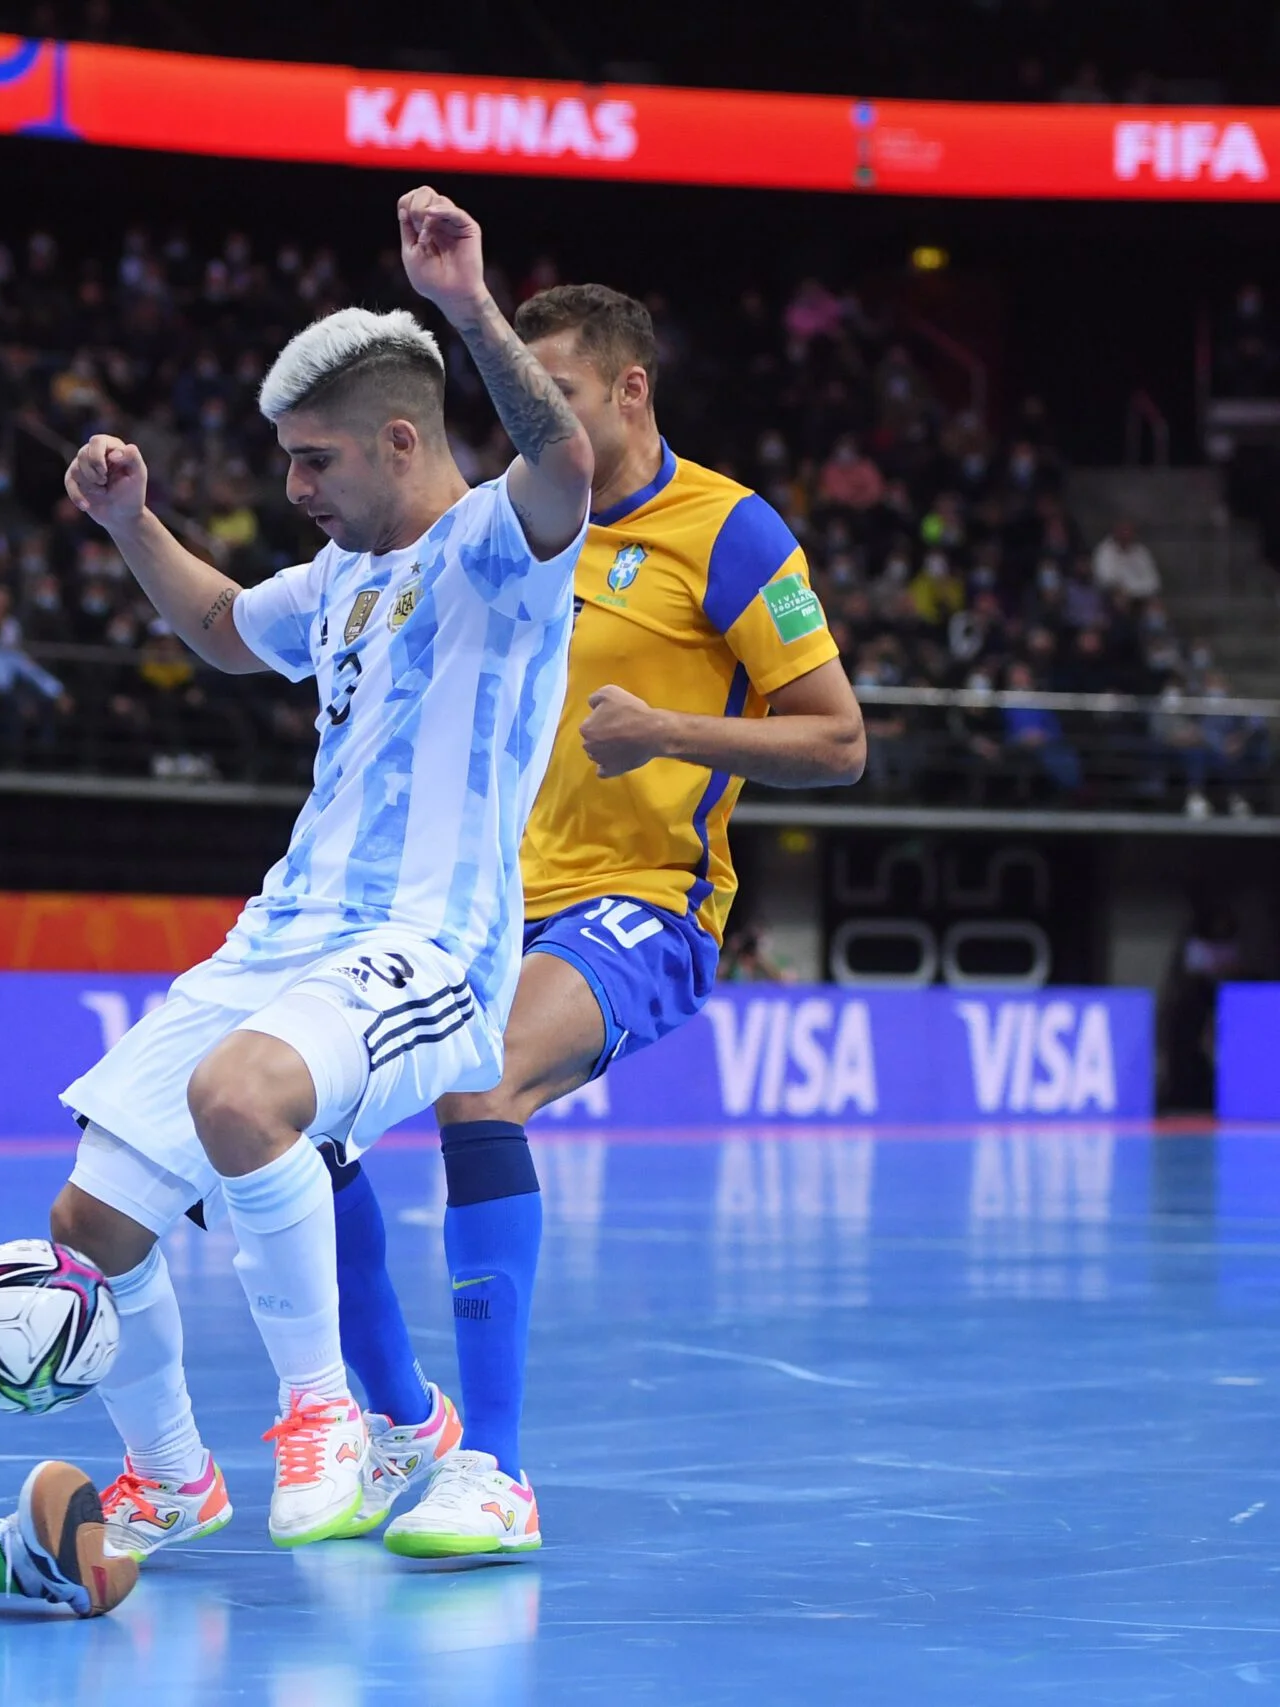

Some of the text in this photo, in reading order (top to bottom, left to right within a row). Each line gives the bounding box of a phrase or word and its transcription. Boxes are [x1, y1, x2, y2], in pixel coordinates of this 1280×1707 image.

[346, 86, 637, 162] KAUNAS
[1114, 120, 1268, 182] FIFA
[583, 897, 665, 949] 10
[358, 952, 415, 989] 3
[706, 999, 878, 1117] VISA
[955, 1002, 1118, 1114] VISA
[256, 1294, 294, 1311] AFA
